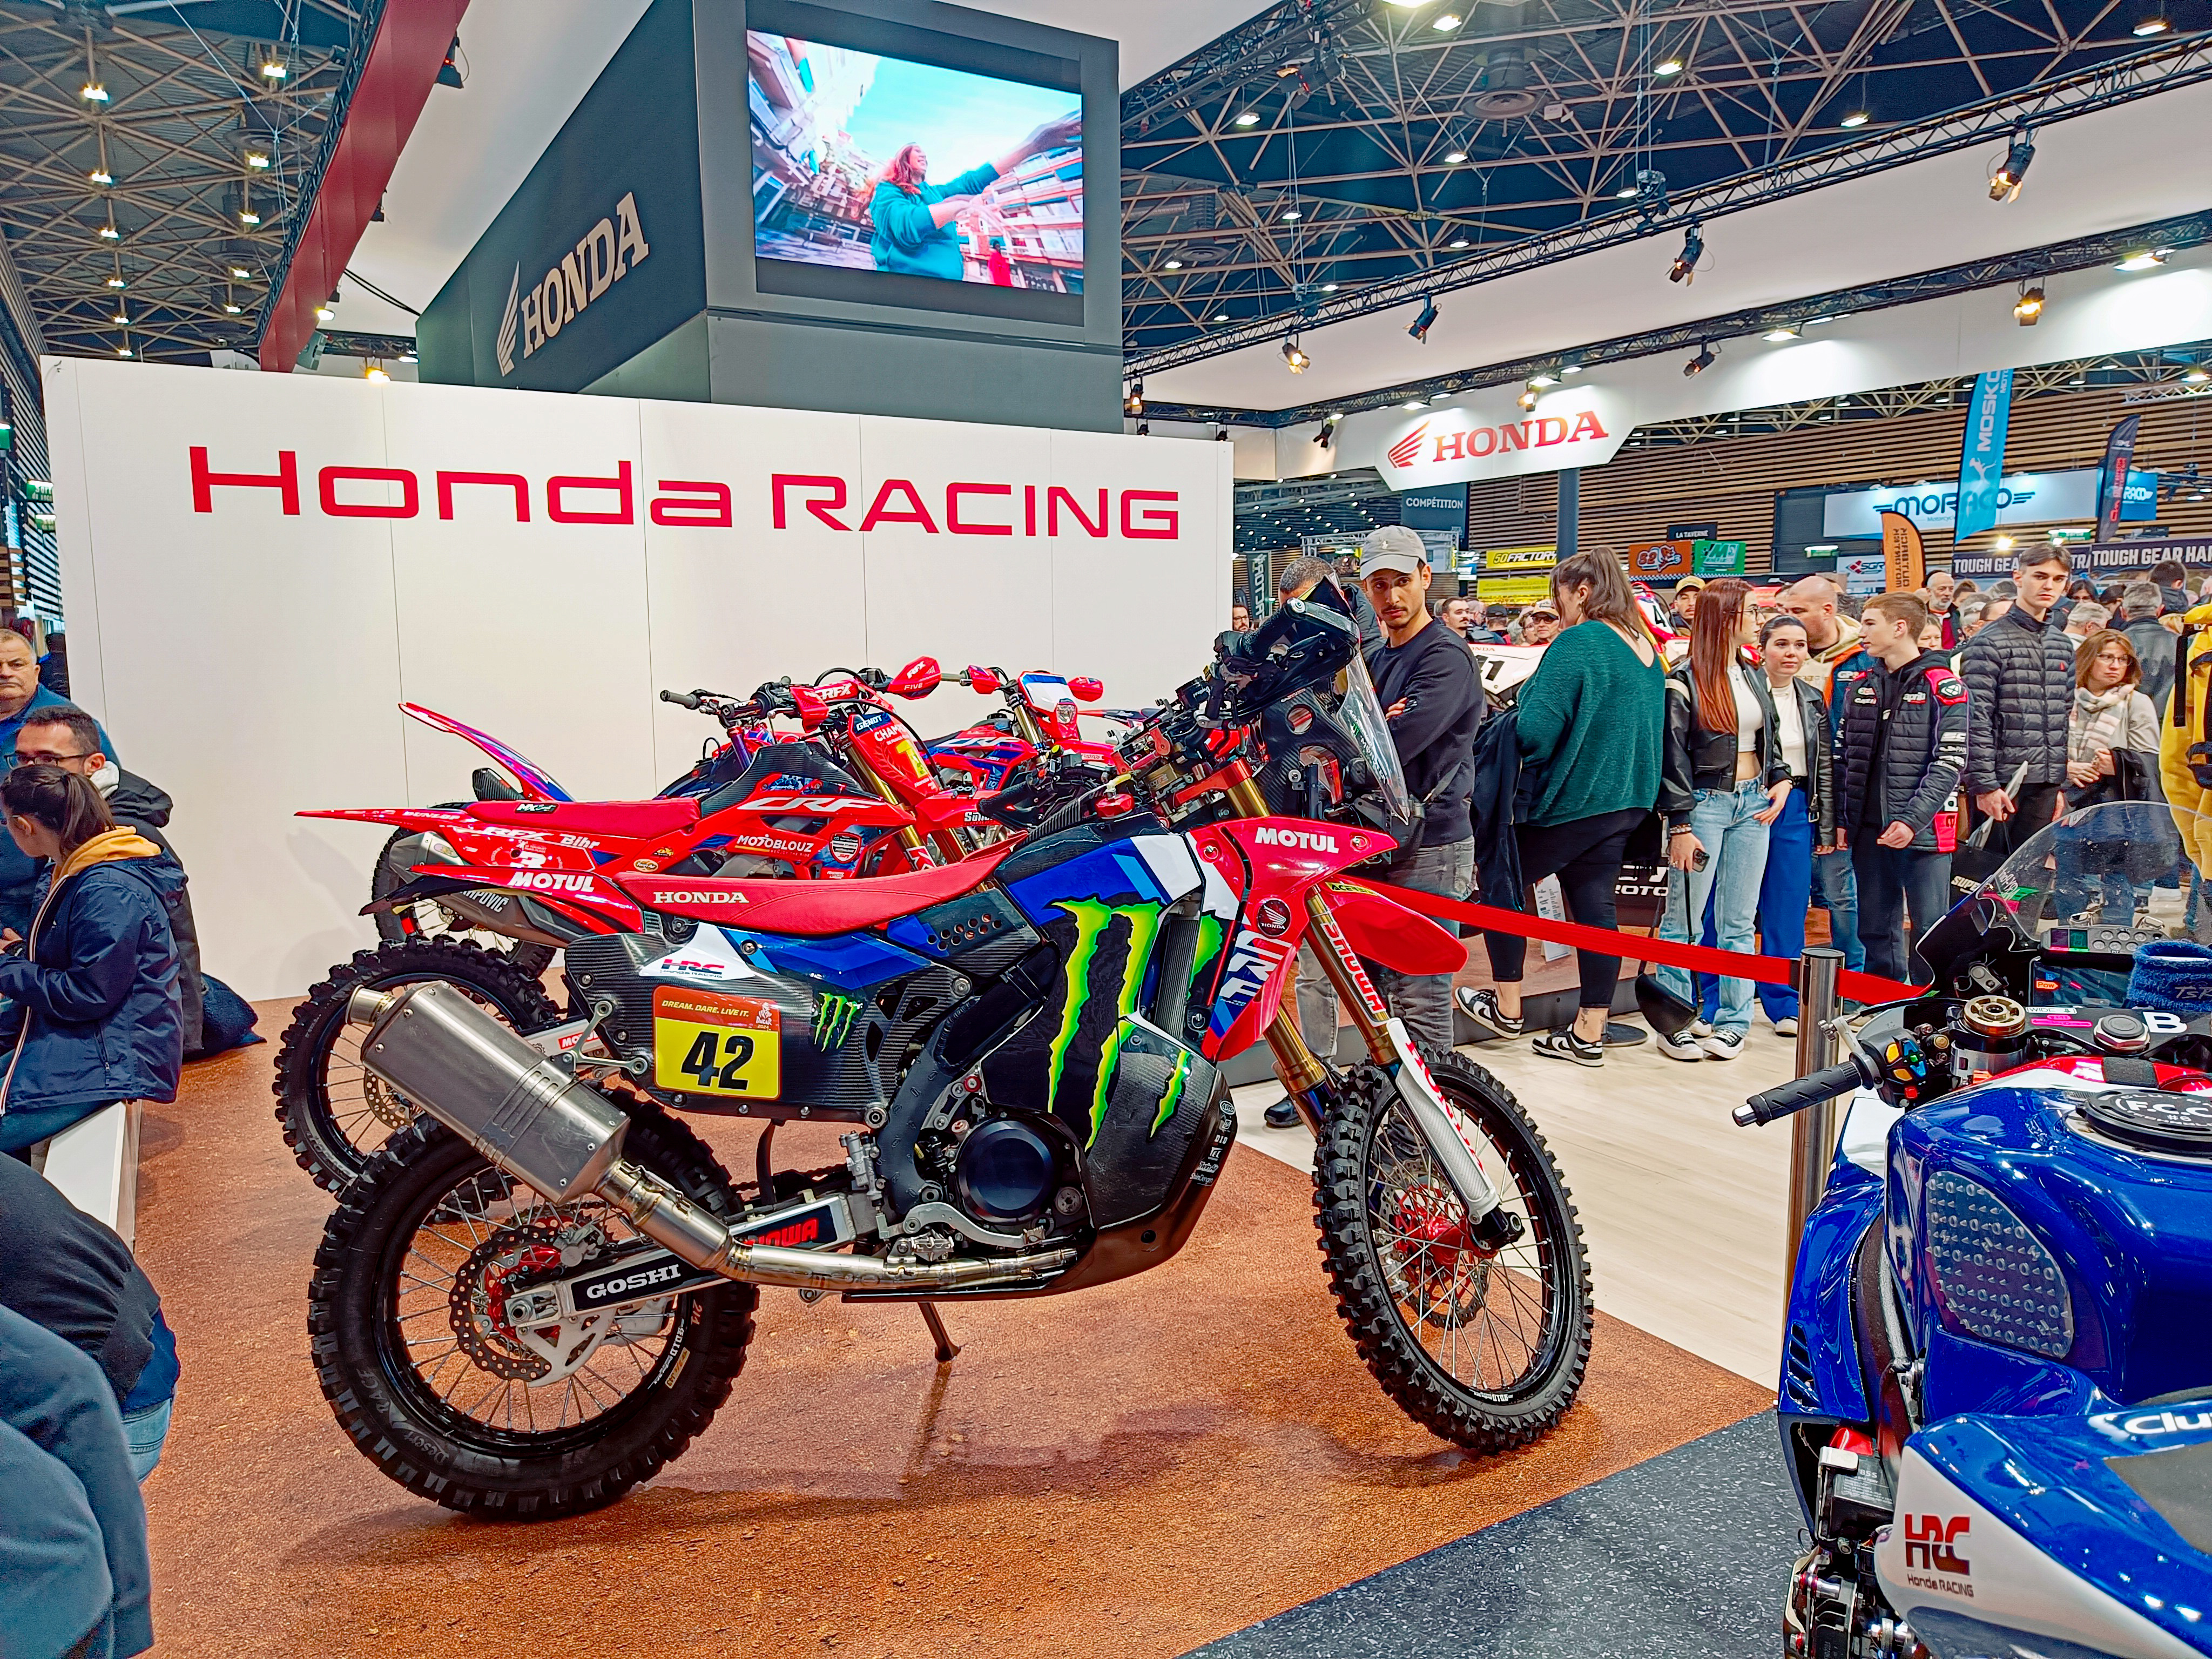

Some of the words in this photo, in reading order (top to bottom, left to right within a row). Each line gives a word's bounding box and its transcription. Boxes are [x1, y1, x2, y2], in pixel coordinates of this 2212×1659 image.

[521, 191, 649, 359] HONDA
[1433, 411, 1609, 462] HONDA
[190, 446, 732, 527] Honda
[771, 473, 1179, 539] RACING
[1406, 497, 1464, 509] COMPÉTITION
[1953, 558, 1993, 574] TOUGH
[1994, 556, 2020, 572] GEA
[2092, 549, 2139, 567] TOUGH
[2141, 546, 2183, 565] GEAR
[1653, 605, 1666, 628] 4
[907, 661, 926, 679] RFX
[904, 682, 923, 690] FIVE
[936, 736, 1021, 748] CRF
[737, 797, 887, 812] CRF
[402, 811, 460, 820] DUNLOP
[559, 833, 600, 849] Bihr
[737, 834, 814, 853] MOTOBLOUZ
[1255, 827, 1339, 853] MOTUL
[507, 871, 595, 893] MOTUL
[653, 891, 750, 903] HONDA
[1261, 922, 1286, 930] HONDA
[661, 959, 725, 975] HRC
[1220, 929, 1292, 999] CRF
[1321, 921, 1386, 1014] SHOWA
[662, 1000, 693, 1010] DREAM.
[694, 1004, 719, 1014] DARE.
[720, 1008, 739, 1016] LIVE
[756, 1016, 772, 1026] DAKAR
[2143, 1011, 2188, 1033] B
[680, 1030, 754, 1091] 42
[586, 1263, 681, 1299] GOSHI
[2124, 1411, 2212, 1435] Clu
[1904, 1514, 1972, 1576] HRC
[1907, 1574, 1938, 1590] Honda
[1939, 1576, 1974, 1598] RACING
